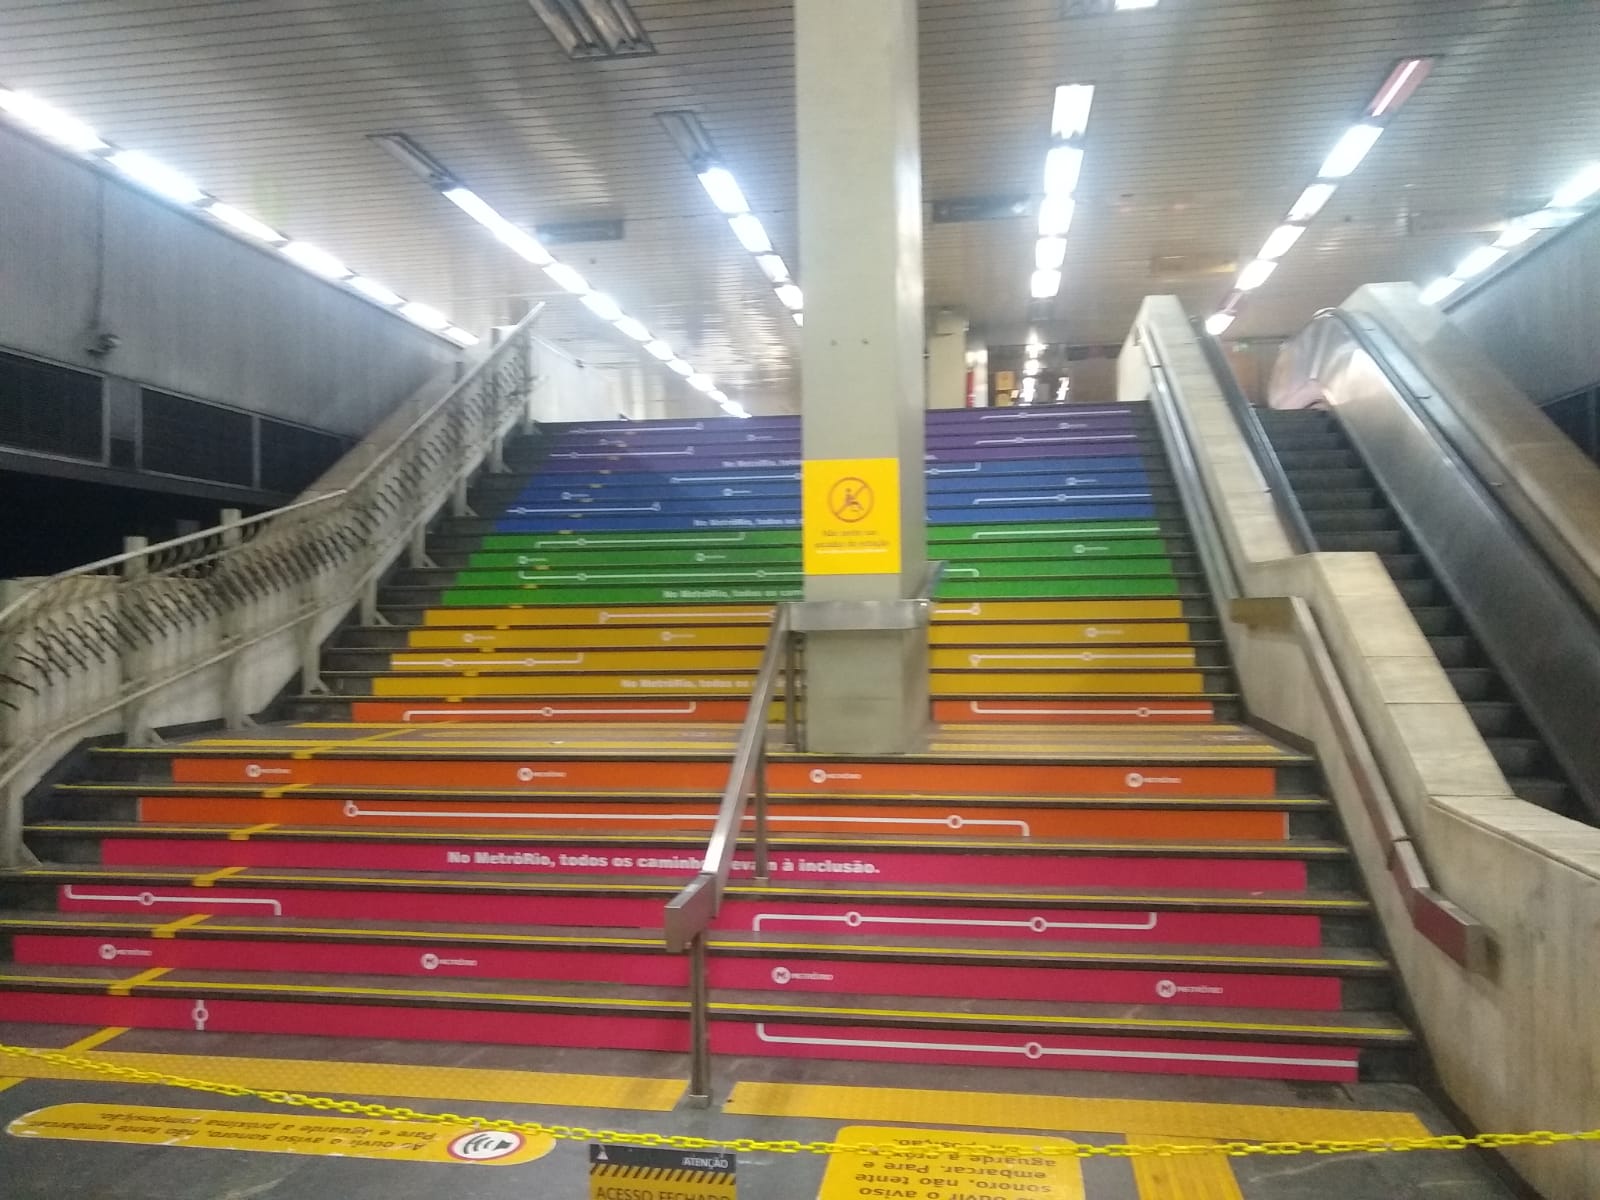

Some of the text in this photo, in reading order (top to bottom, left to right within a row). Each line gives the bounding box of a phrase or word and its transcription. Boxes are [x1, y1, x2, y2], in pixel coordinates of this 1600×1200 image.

[559, 854, 608, 866] todos
[611, 857, 633, 867] os
[636, 856, 716, 869] caminh
[782, 858, 795, 871] à
[798, 859, 880, 873] inclusão.
[276, 1135, 325, 1144] aviso
[397, 1131, 437, 1140] Pare
[949, 1152, 960, 1161] a
[970, 1154, 1056, 1168] aguarde
[884, 1162, 929, 1173] Pare
[855, 1174, 909, 1184] tente
[920, 1178, 958, 1187] não
[597, 1187, 653, 1200] ACESSO
[859, 1187, 917, 1199] aviso
